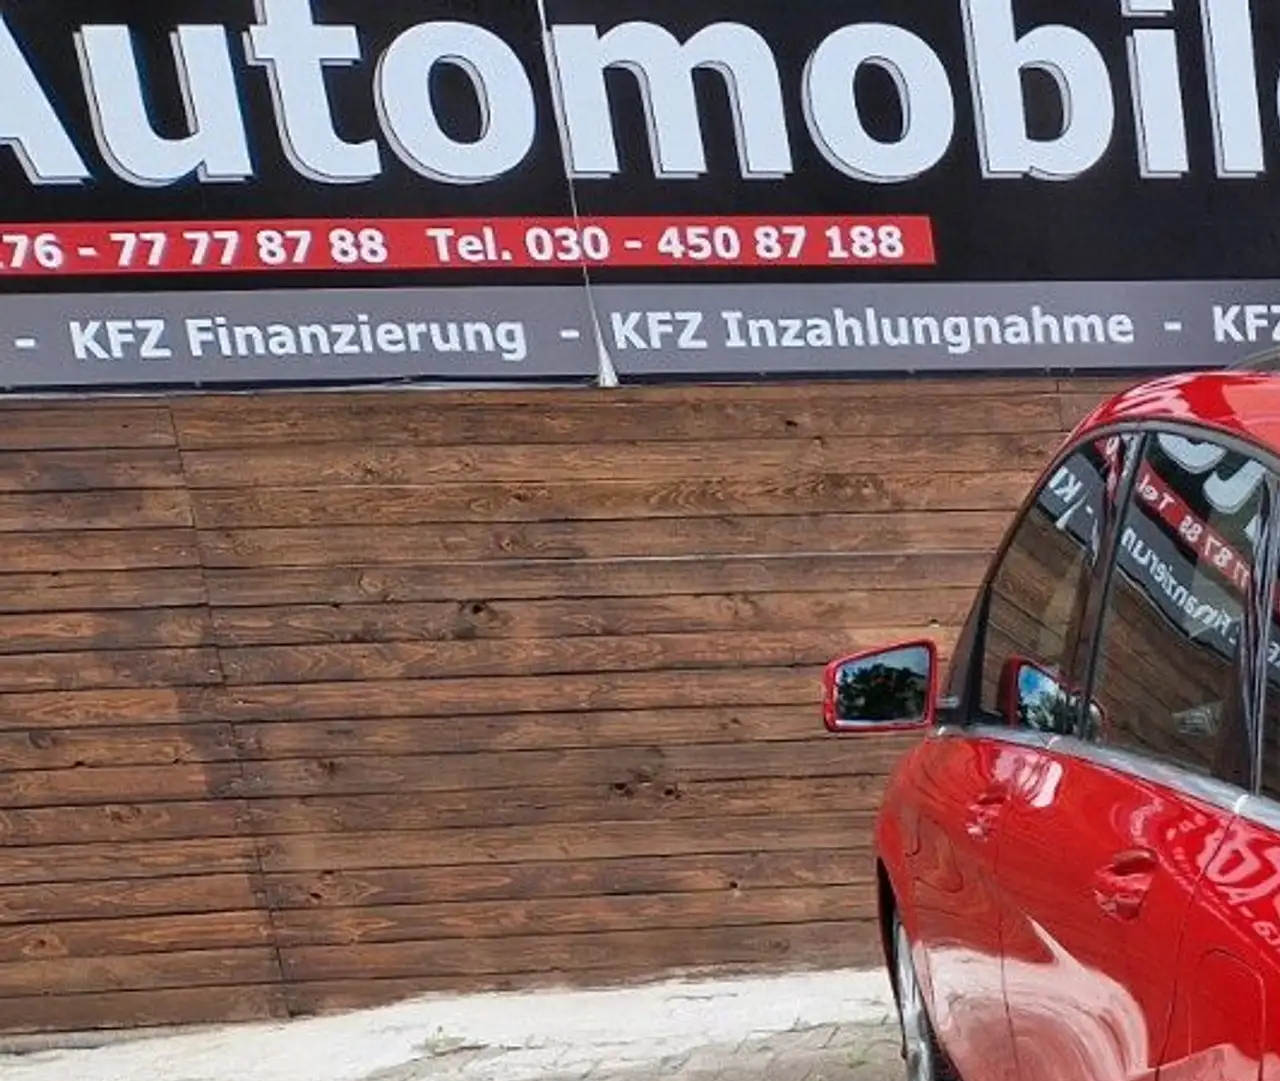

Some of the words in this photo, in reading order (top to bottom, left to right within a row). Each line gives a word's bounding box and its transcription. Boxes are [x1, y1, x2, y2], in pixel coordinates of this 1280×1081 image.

[0, 233, 63, 268] 76
[110, 232, 166, 266] 77
[183, 230, 239, 265] 77
[256, 229, 312, 264] 87
[328, 228, 388, 263] 88
[427, 226, 512, 262] Tel.
[525, 226, 609, 261] 030
[657, 225, 741, 260] 450
[754, 225, 806, 259] 87
[825, 224, 904, 259] 188
[69, 319, 172, 360] KFZ
[185, 314, 527, 362] Finanzierung
[611, 310, 708, 350] KFZ
[721, 305, 1135, 354] Inzahlungnahme
